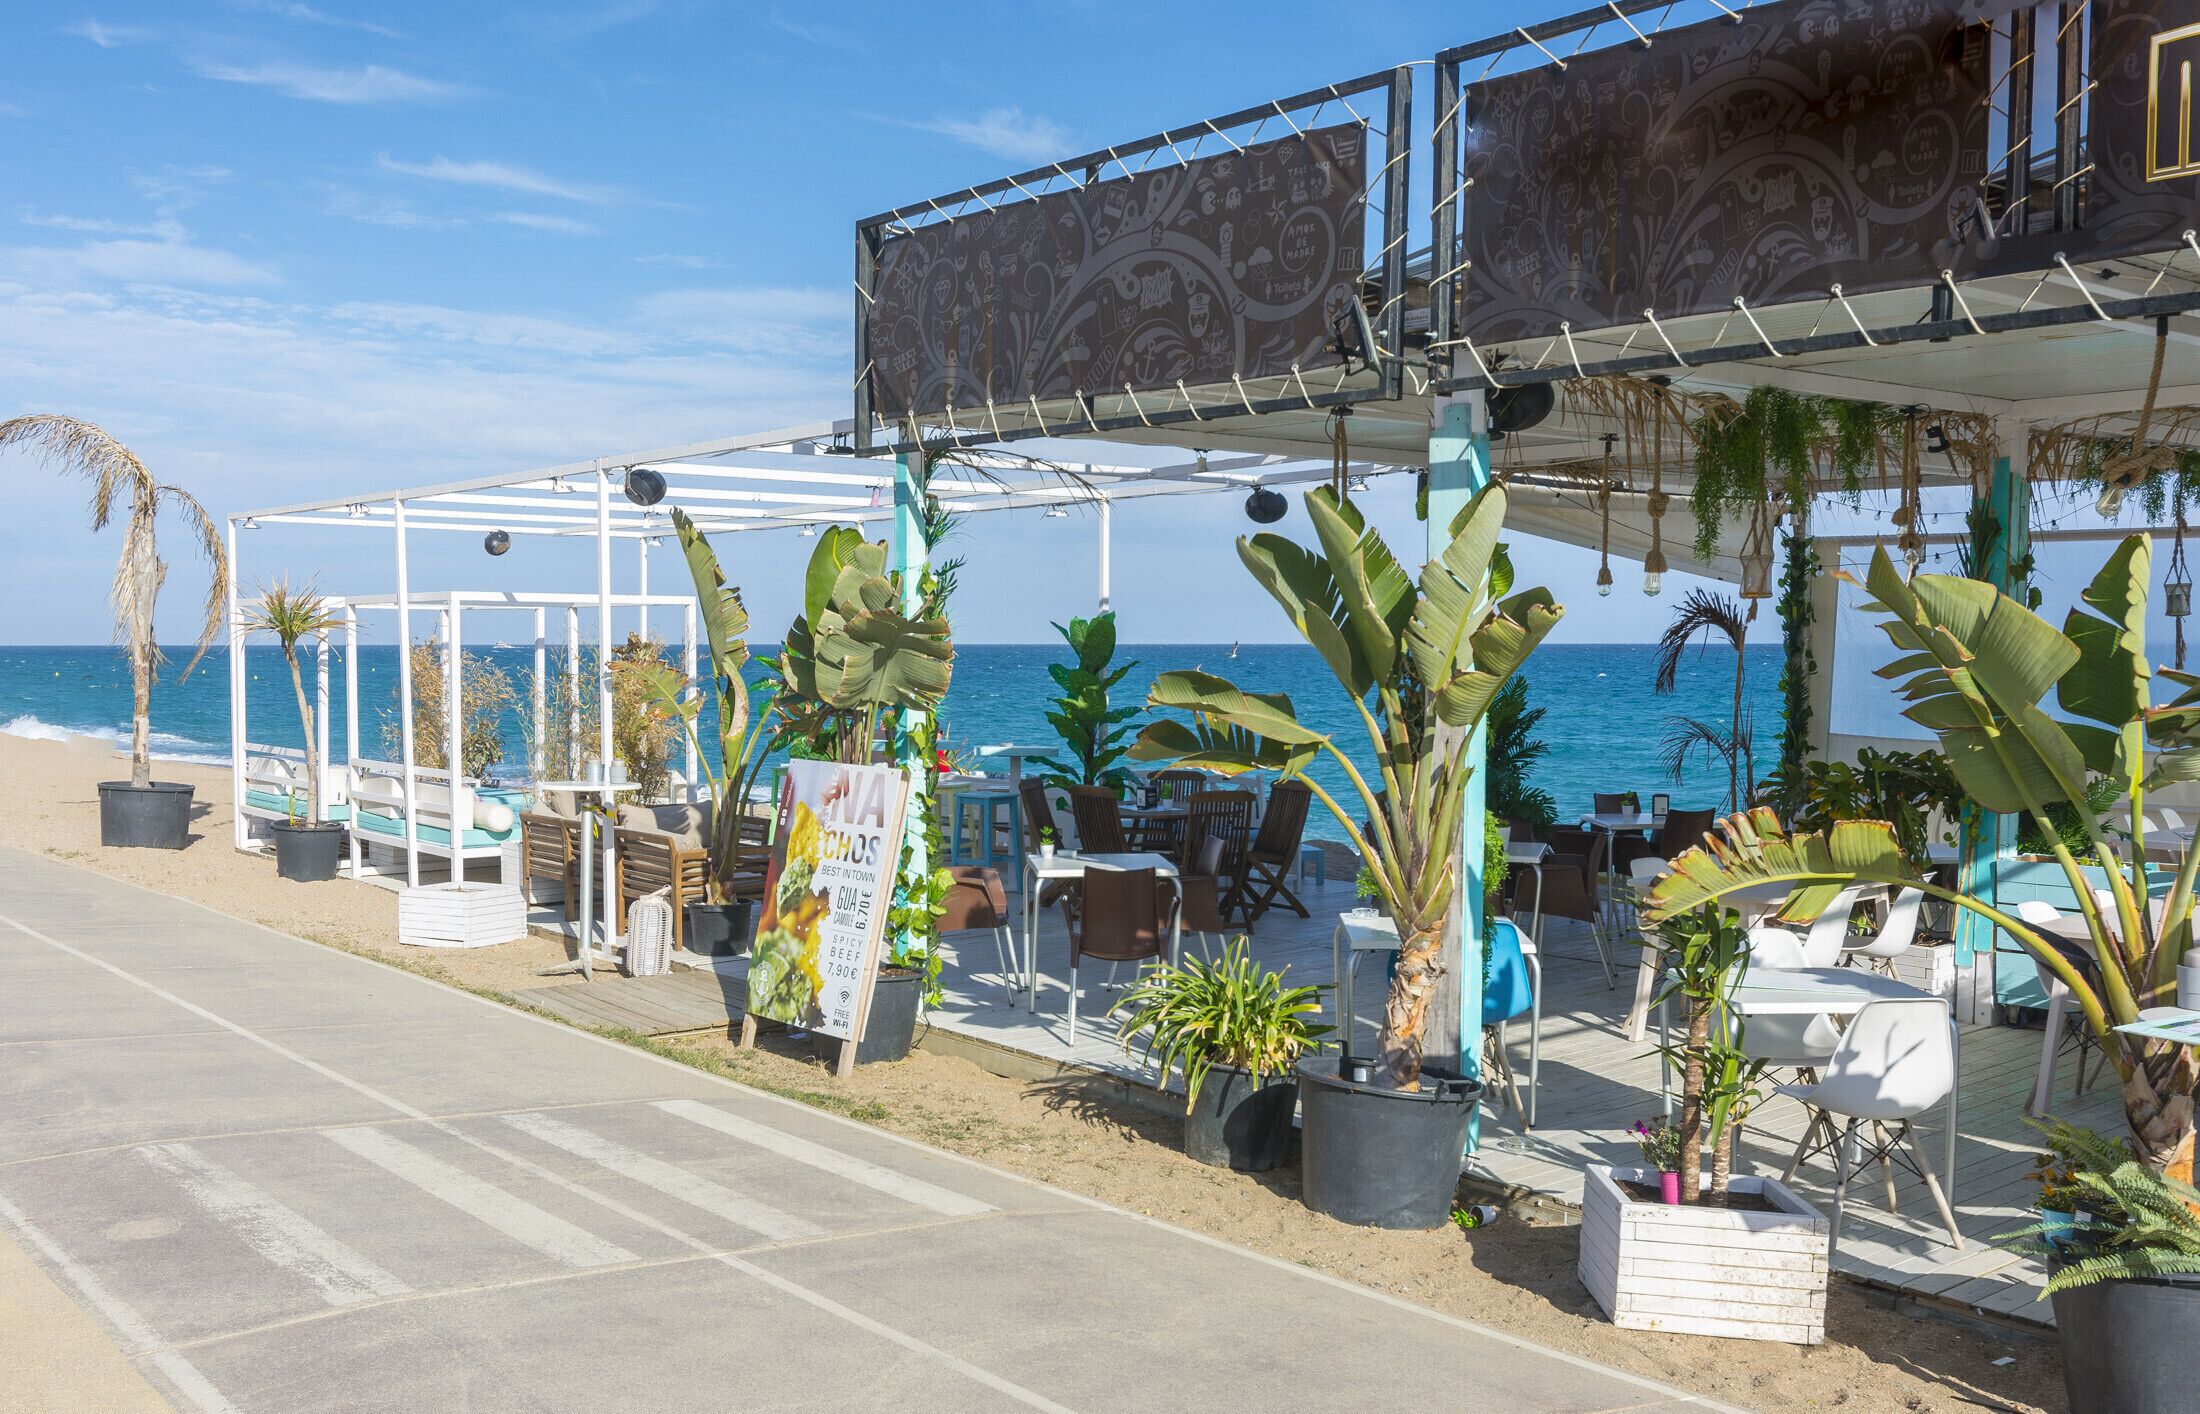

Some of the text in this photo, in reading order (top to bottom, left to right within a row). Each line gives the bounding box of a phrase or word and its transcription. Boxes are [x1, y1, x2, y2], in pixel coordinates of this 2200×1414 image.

[1287, 222, 1315, 238] AMOR
[1286, 246, 1315, 261] MADRE
[1273, 280, 1302, 293] Toilets
[831, 769, 886, 828] NA
[822, 829, 881, 866] CHOS
[821, 865, 876, 883] BEST IN TOWN
[836, 885, 858, 911] GUA
[832, 934, 863, 948] SPICY
[829, 946, 861, 962] BEEF
[826, 962, 858, 979] 7,90€
[834, 1008, 850, 1020] FREE
